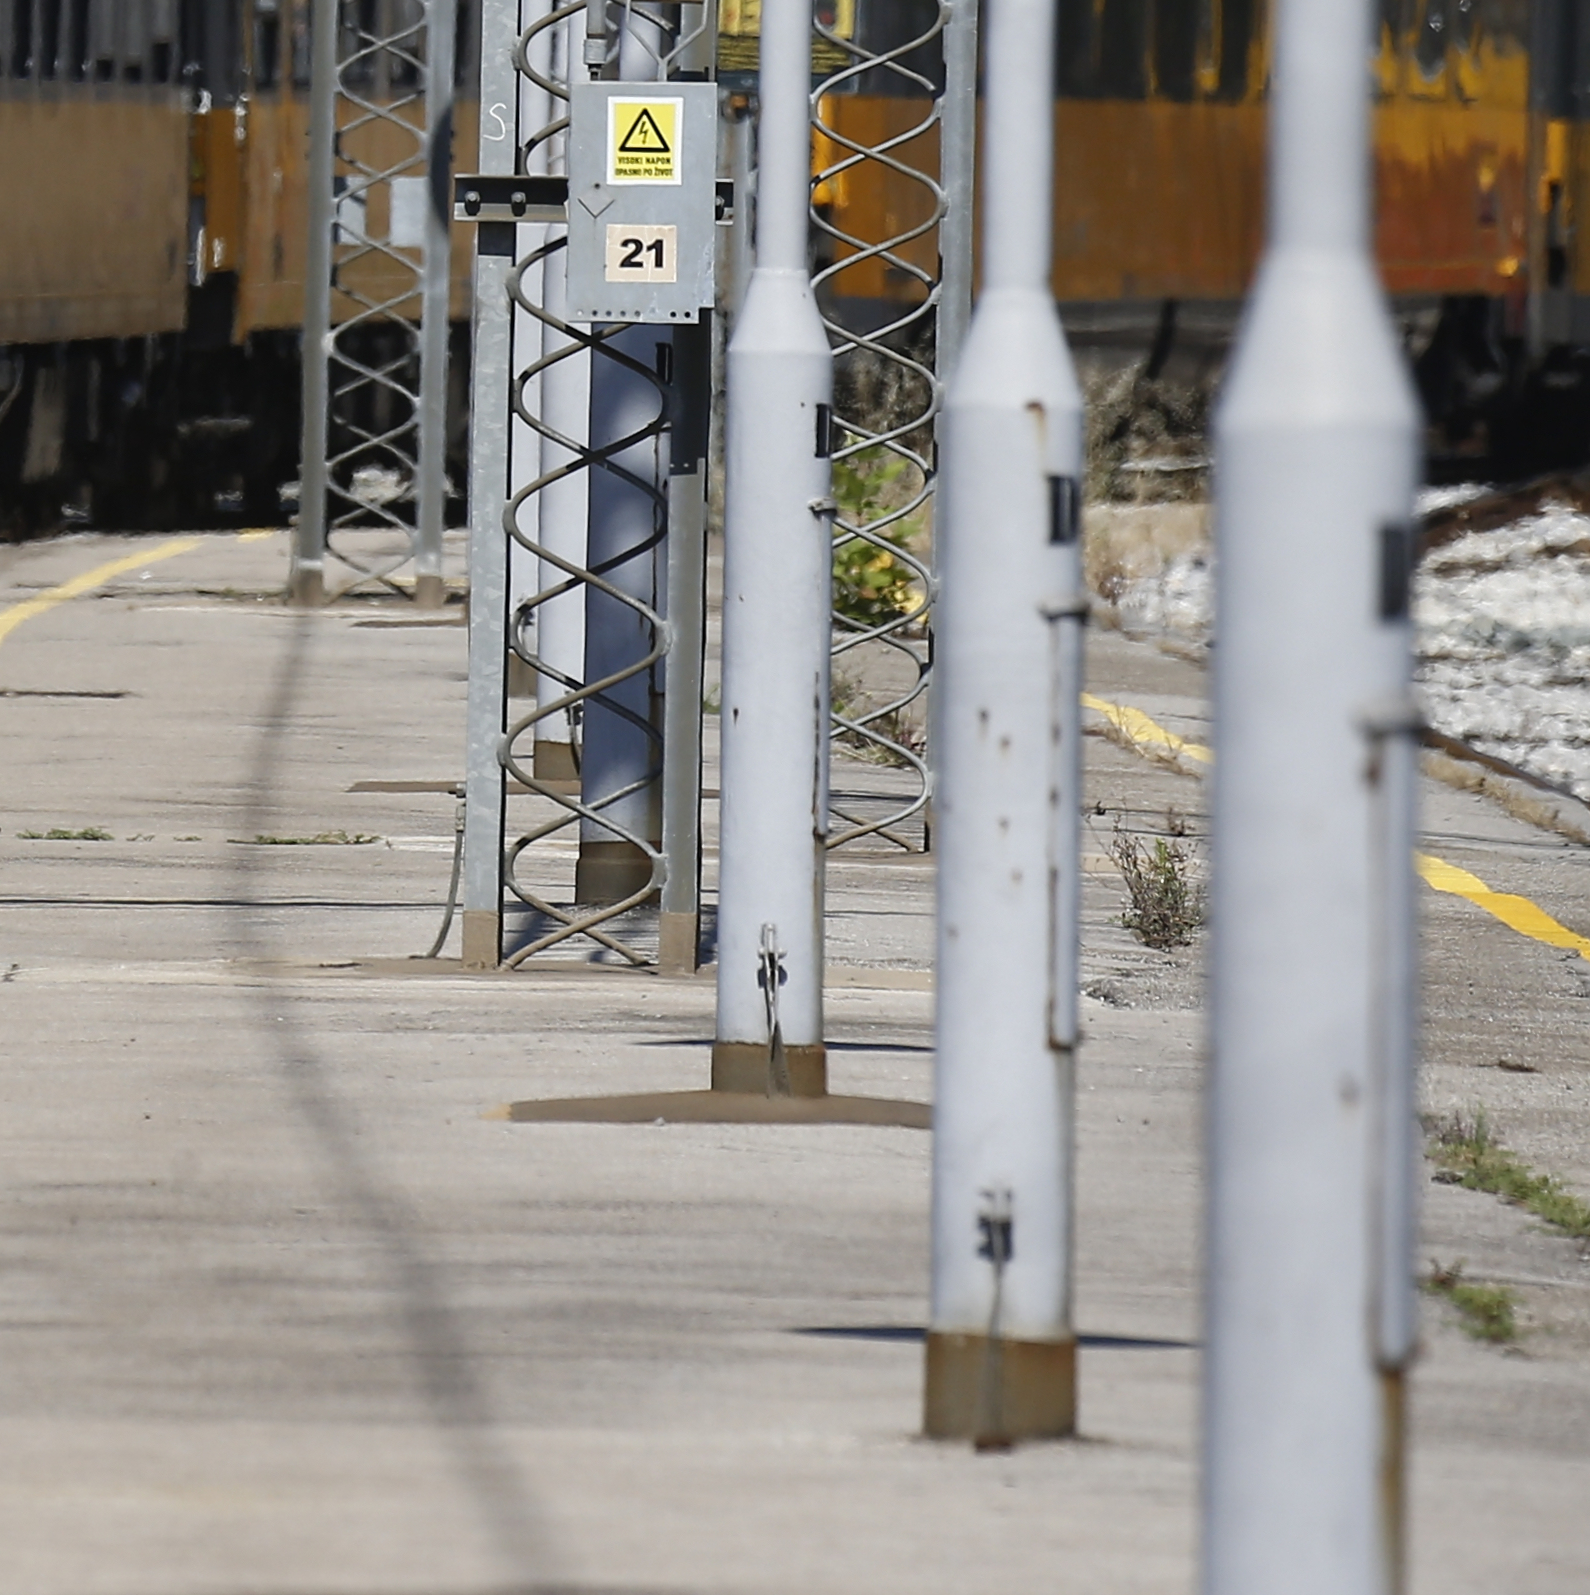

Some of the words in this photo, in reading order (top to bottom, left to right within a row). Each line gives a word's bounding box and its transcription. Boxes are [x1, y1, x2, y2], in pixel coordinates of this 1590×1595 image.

[617, 156, 643, 165] VISOKI
[645, 156, 671, 165] NAPON
[643, 168, 653, 176] PO
[619, 238, 663, 268] 21
